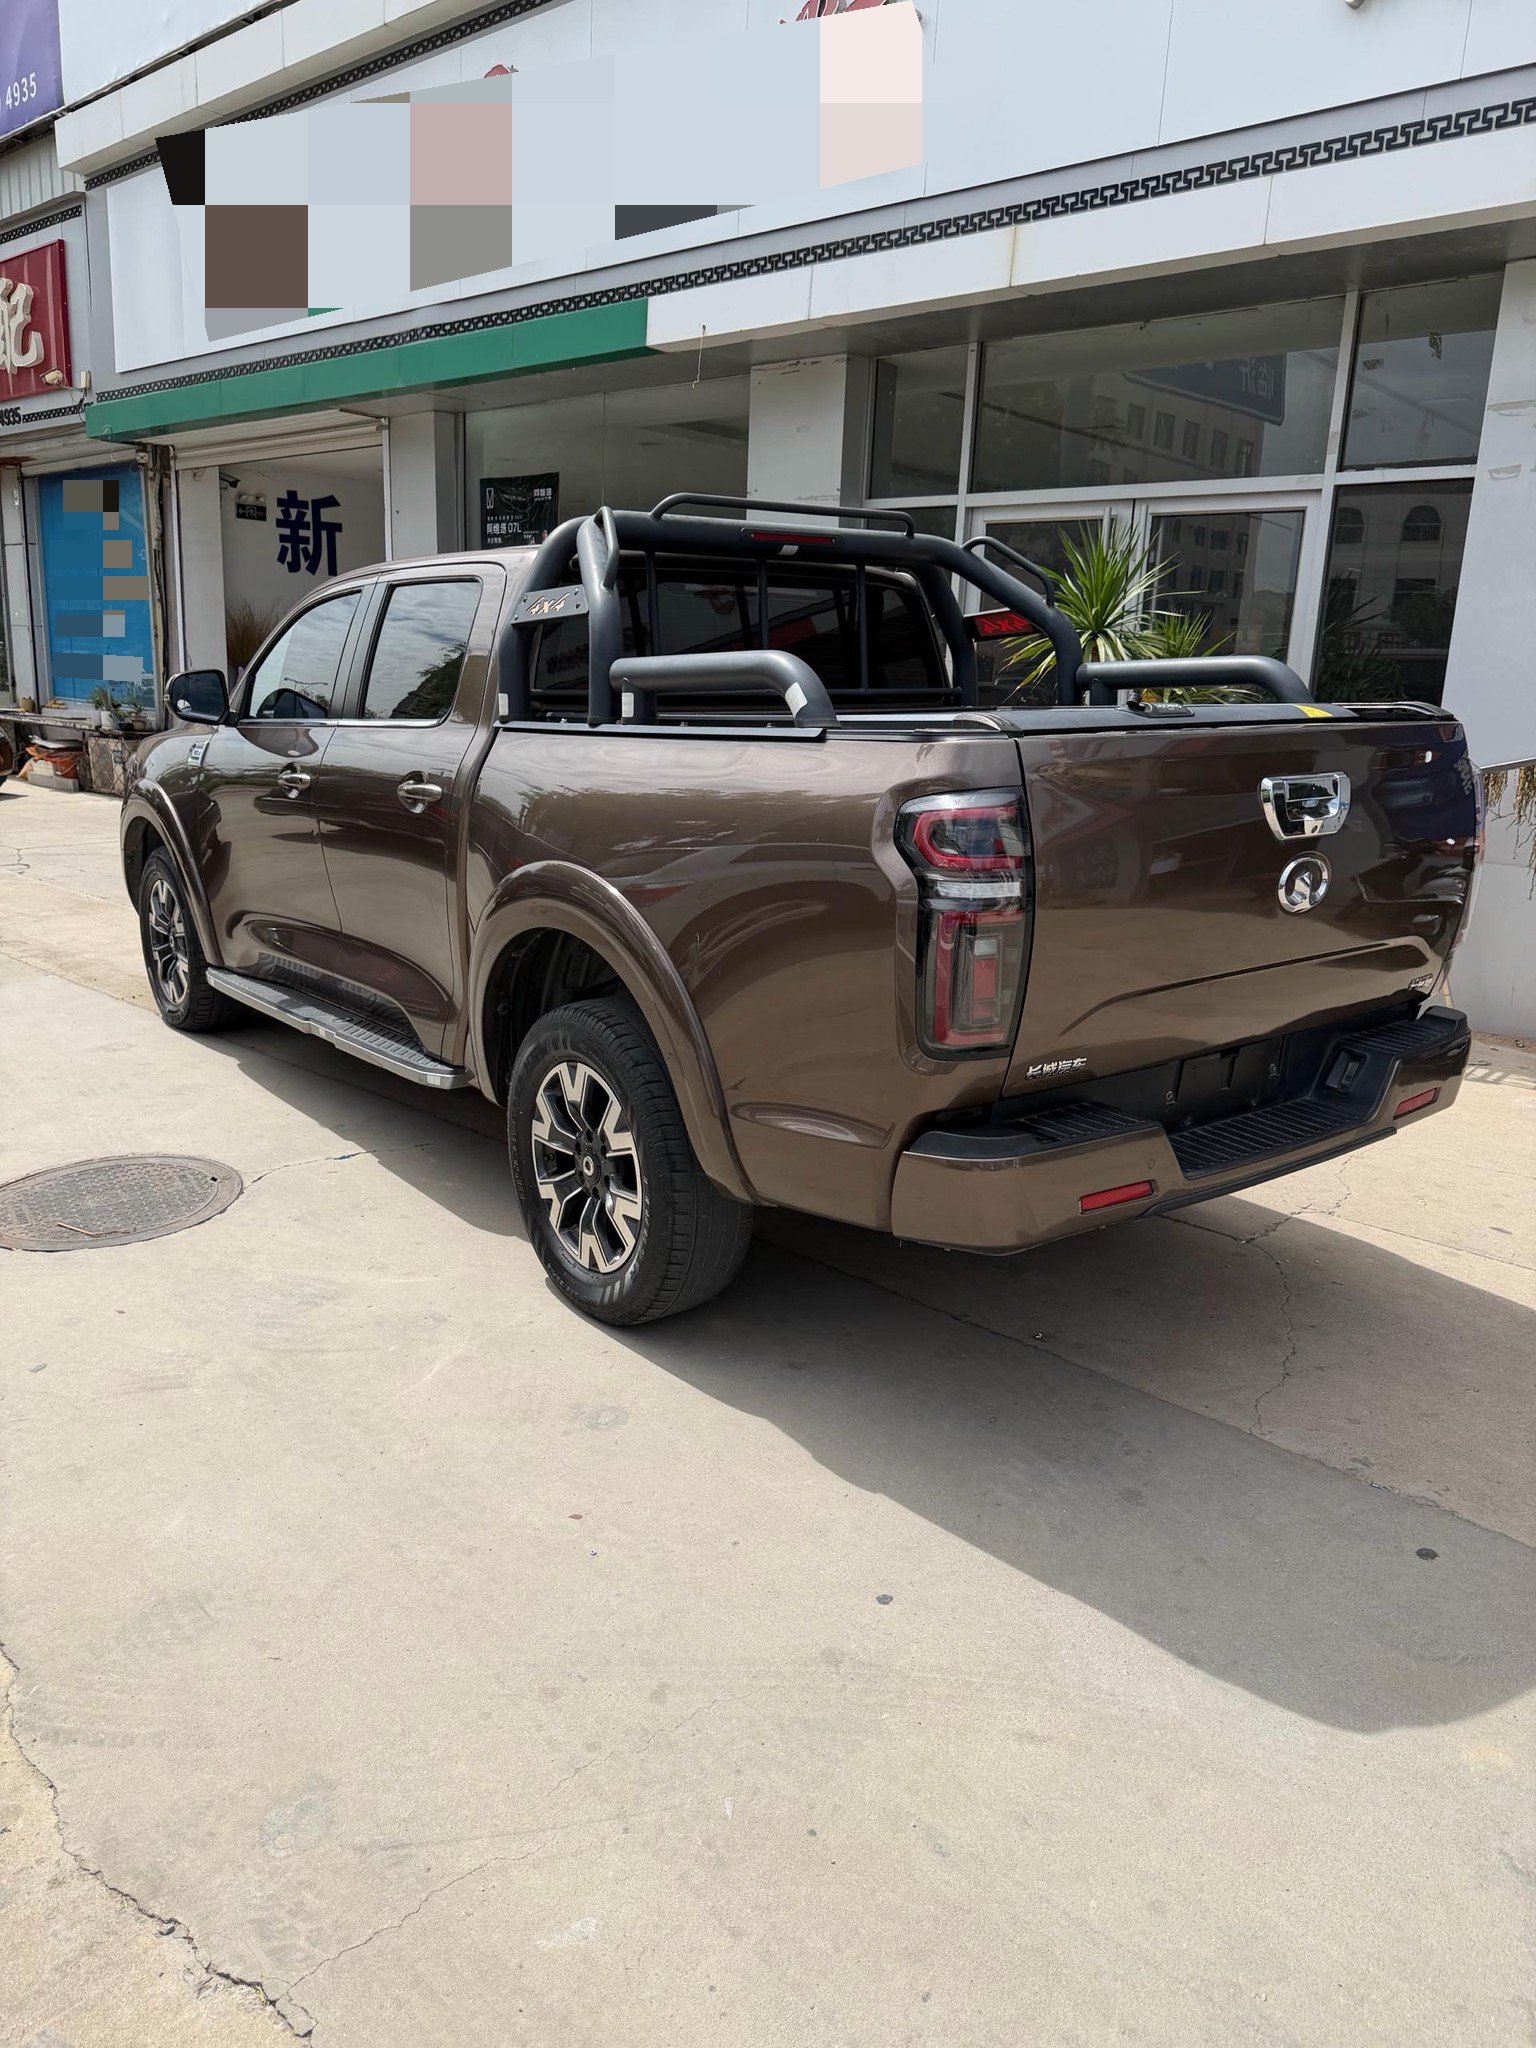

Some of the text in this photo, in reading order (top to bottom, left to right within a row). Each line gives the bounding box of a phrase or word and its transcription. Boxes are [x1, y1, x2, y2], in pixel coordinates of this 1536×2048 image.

[6, 72, 37, 110] 4935
[275, 490, 343, 576] 新
[507, 522, 522, 534] 07L
[1025, 1057, 1088, 1079] 长城汽车
